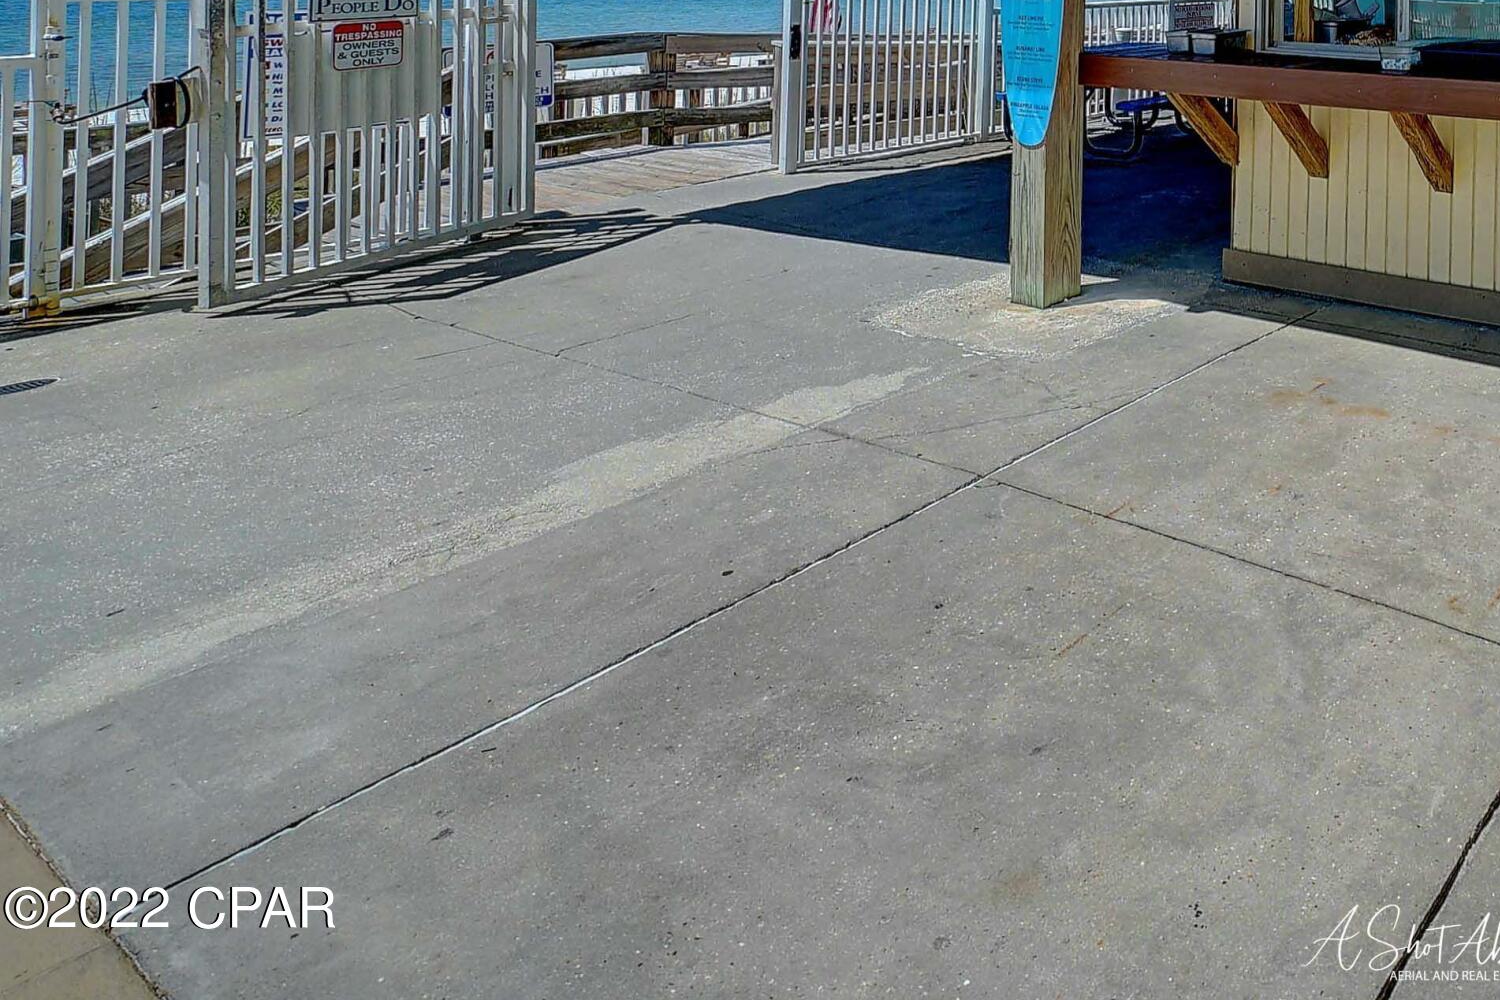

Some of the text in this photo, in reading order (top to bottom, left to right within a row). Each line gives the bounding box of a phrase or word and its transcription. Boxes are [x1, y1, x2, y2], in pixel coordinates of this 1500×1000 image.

[362, 23, 377, 31] NO
[335, 30, 402, 41] TRESPASSING
[343, 40, 395, 50] OWNERS
[351, 47, 399, 58] GUESTS
[353, 57, 384, 66] ONLY
